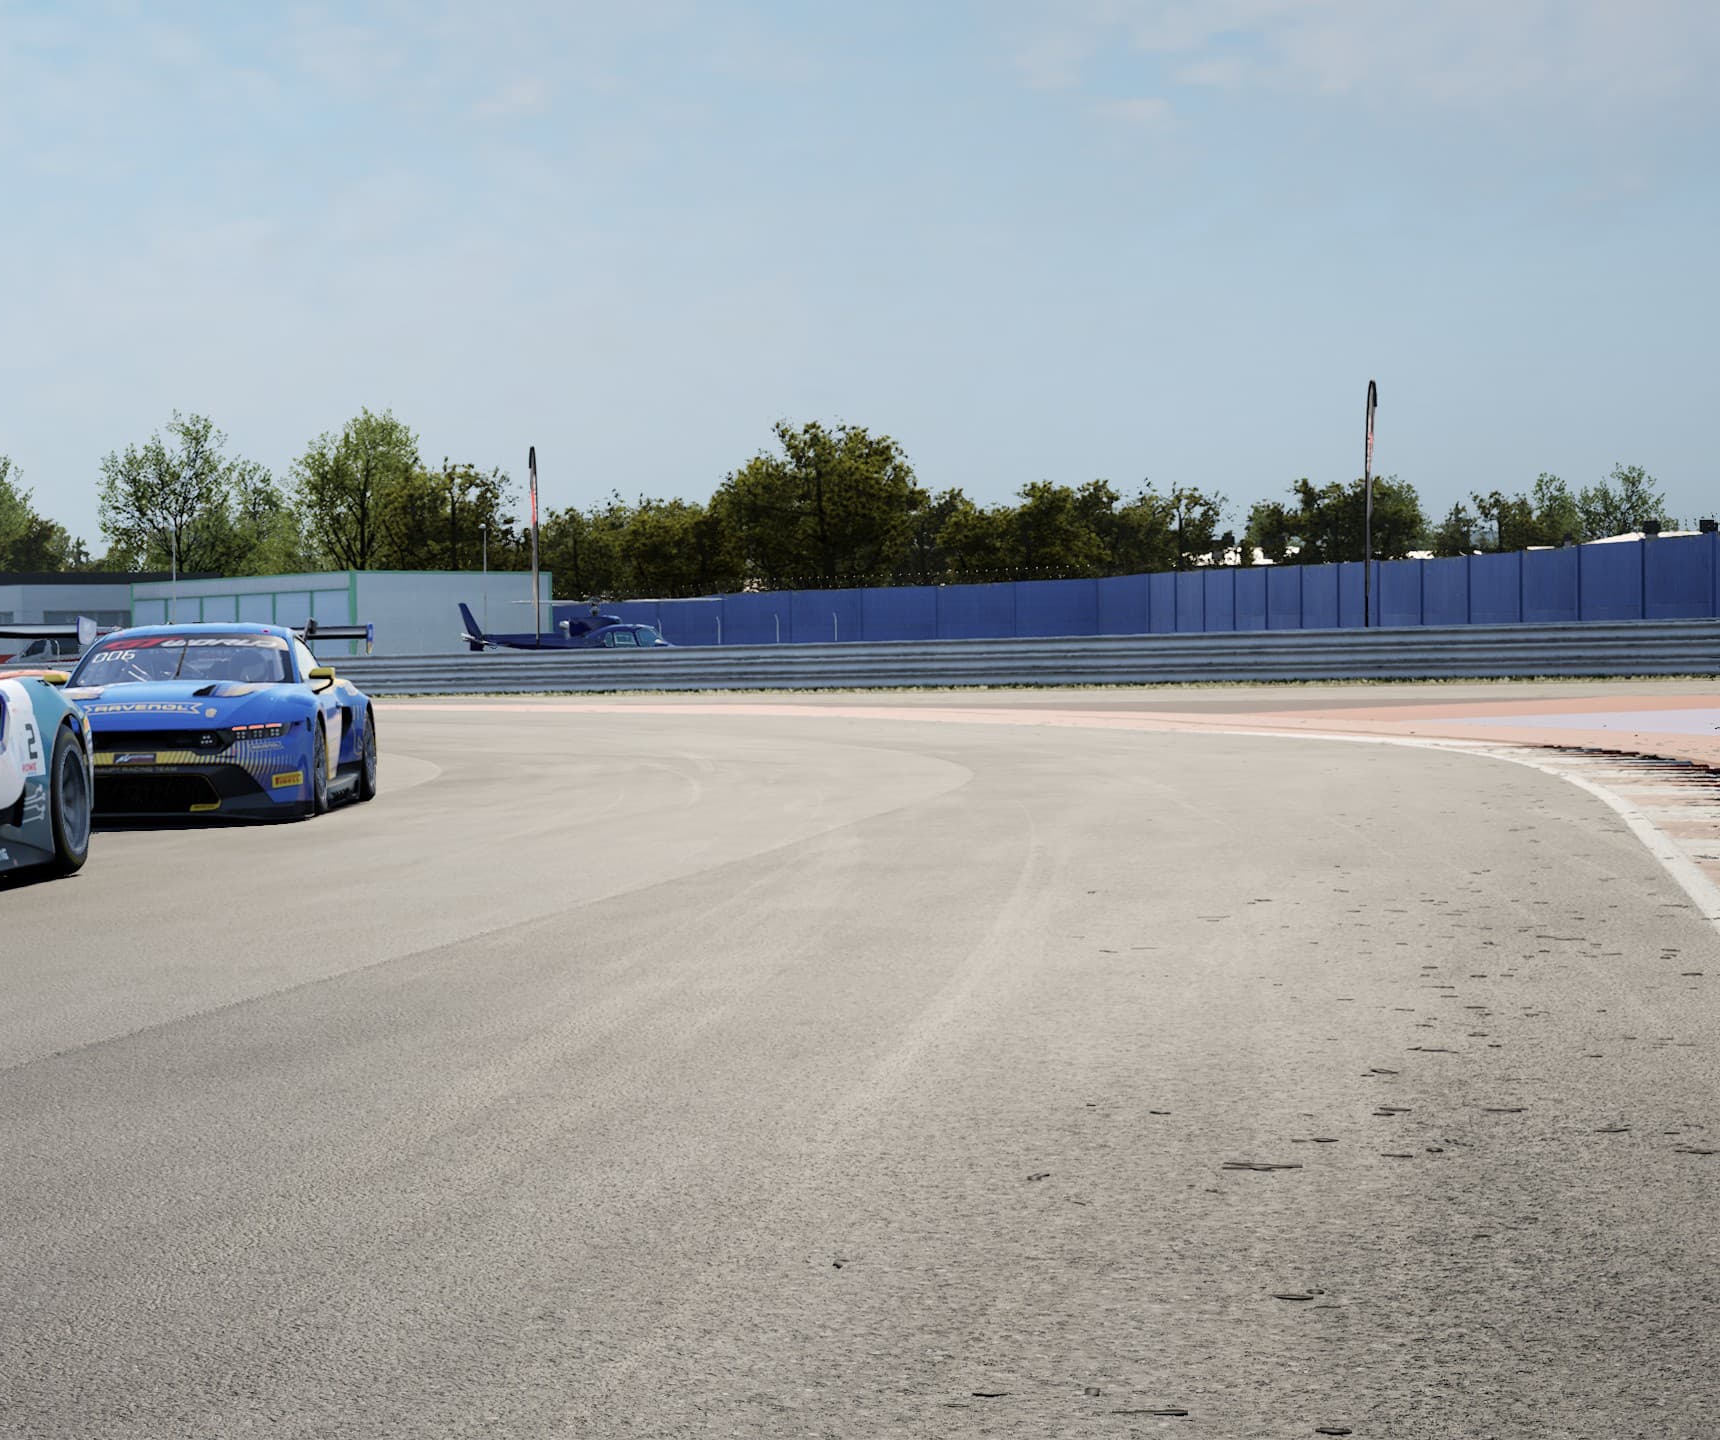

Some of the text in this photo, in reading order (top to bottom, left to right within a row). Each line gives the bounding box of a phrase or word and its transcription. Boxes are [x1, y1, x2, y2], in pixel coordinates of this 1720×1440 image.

[102, 637, 279, 650] GT WORLD
[91, 649, 136, 664] 006
[94, 703, 189, 713] RAVENOL
